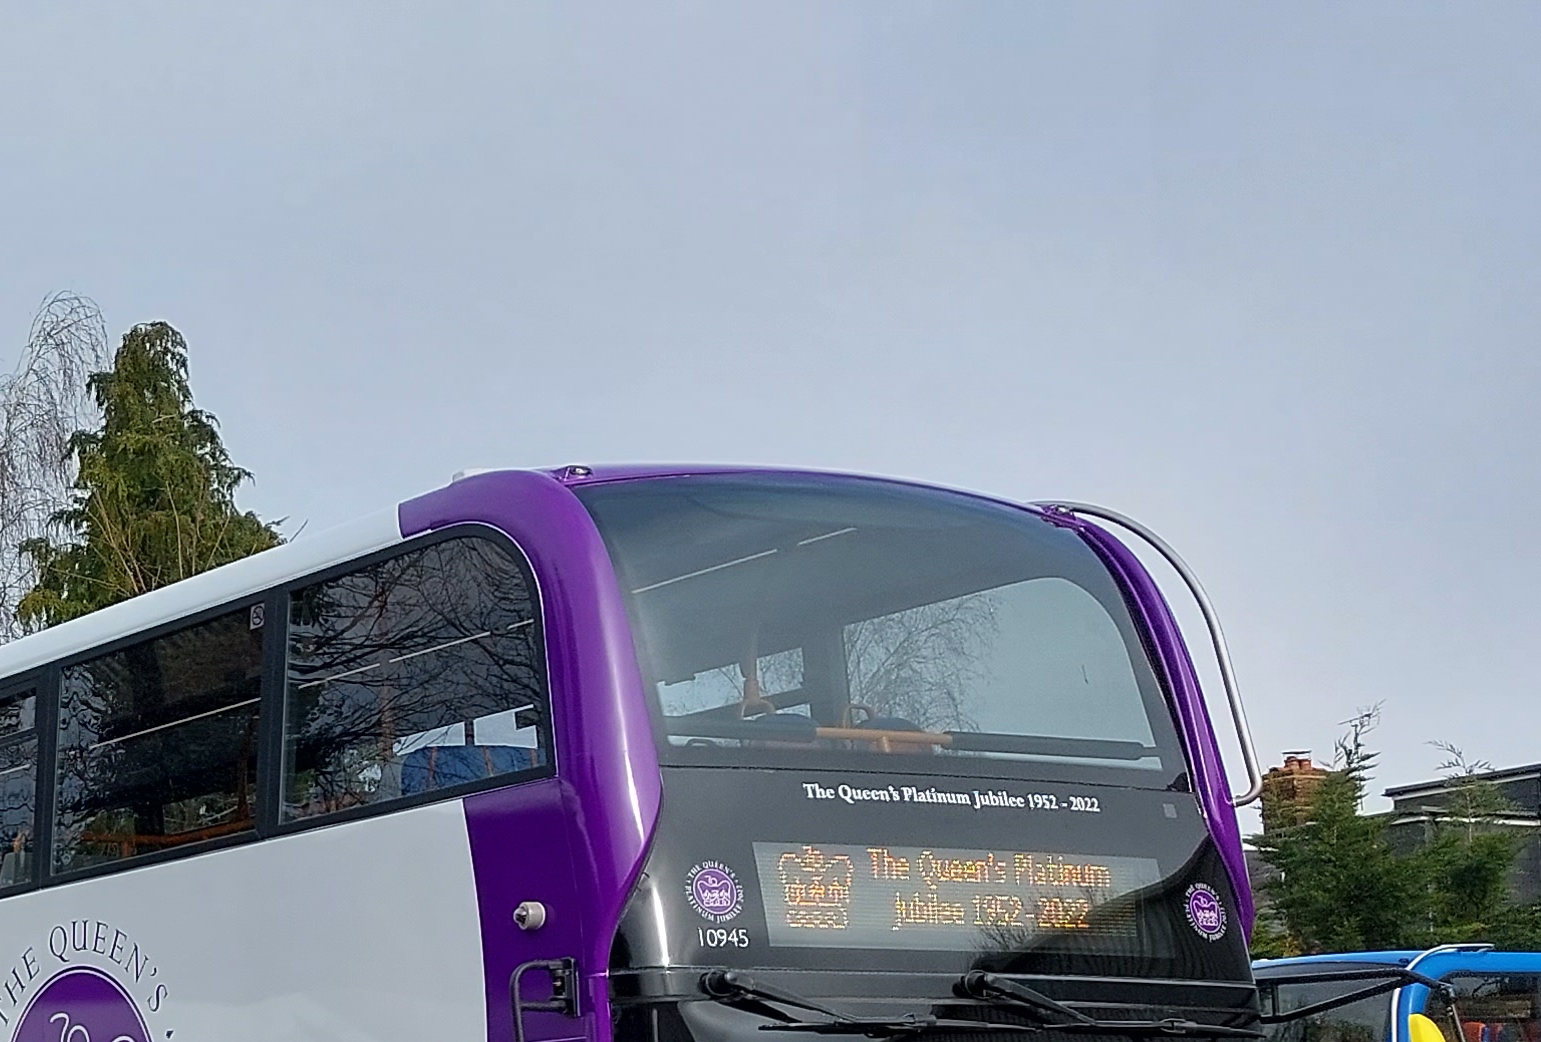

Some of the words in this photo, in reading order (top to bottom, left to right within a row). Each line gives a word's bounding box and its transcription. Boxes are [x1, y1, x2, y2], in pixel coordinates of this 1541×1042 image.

[803, 783, 835, 800] The
[837, 785, 900, 804] Queen's
[901, 786, 972, 806] Platinum
[973, 790, 1026, 809] Jubilee
[1027, 793, 1059, 811] 1952
[1069, 796, 1102, 813] 2022
[867, 847, 910, 880] The
[917, 850, 1007, 890] Queen's
[1013, 853, 1112, 887] Platinum
[891, 891, 965, 931] Jubilee
[698, 926, 749, 948] 10945
[49, 919, 169, 1013] QUEEN'S
